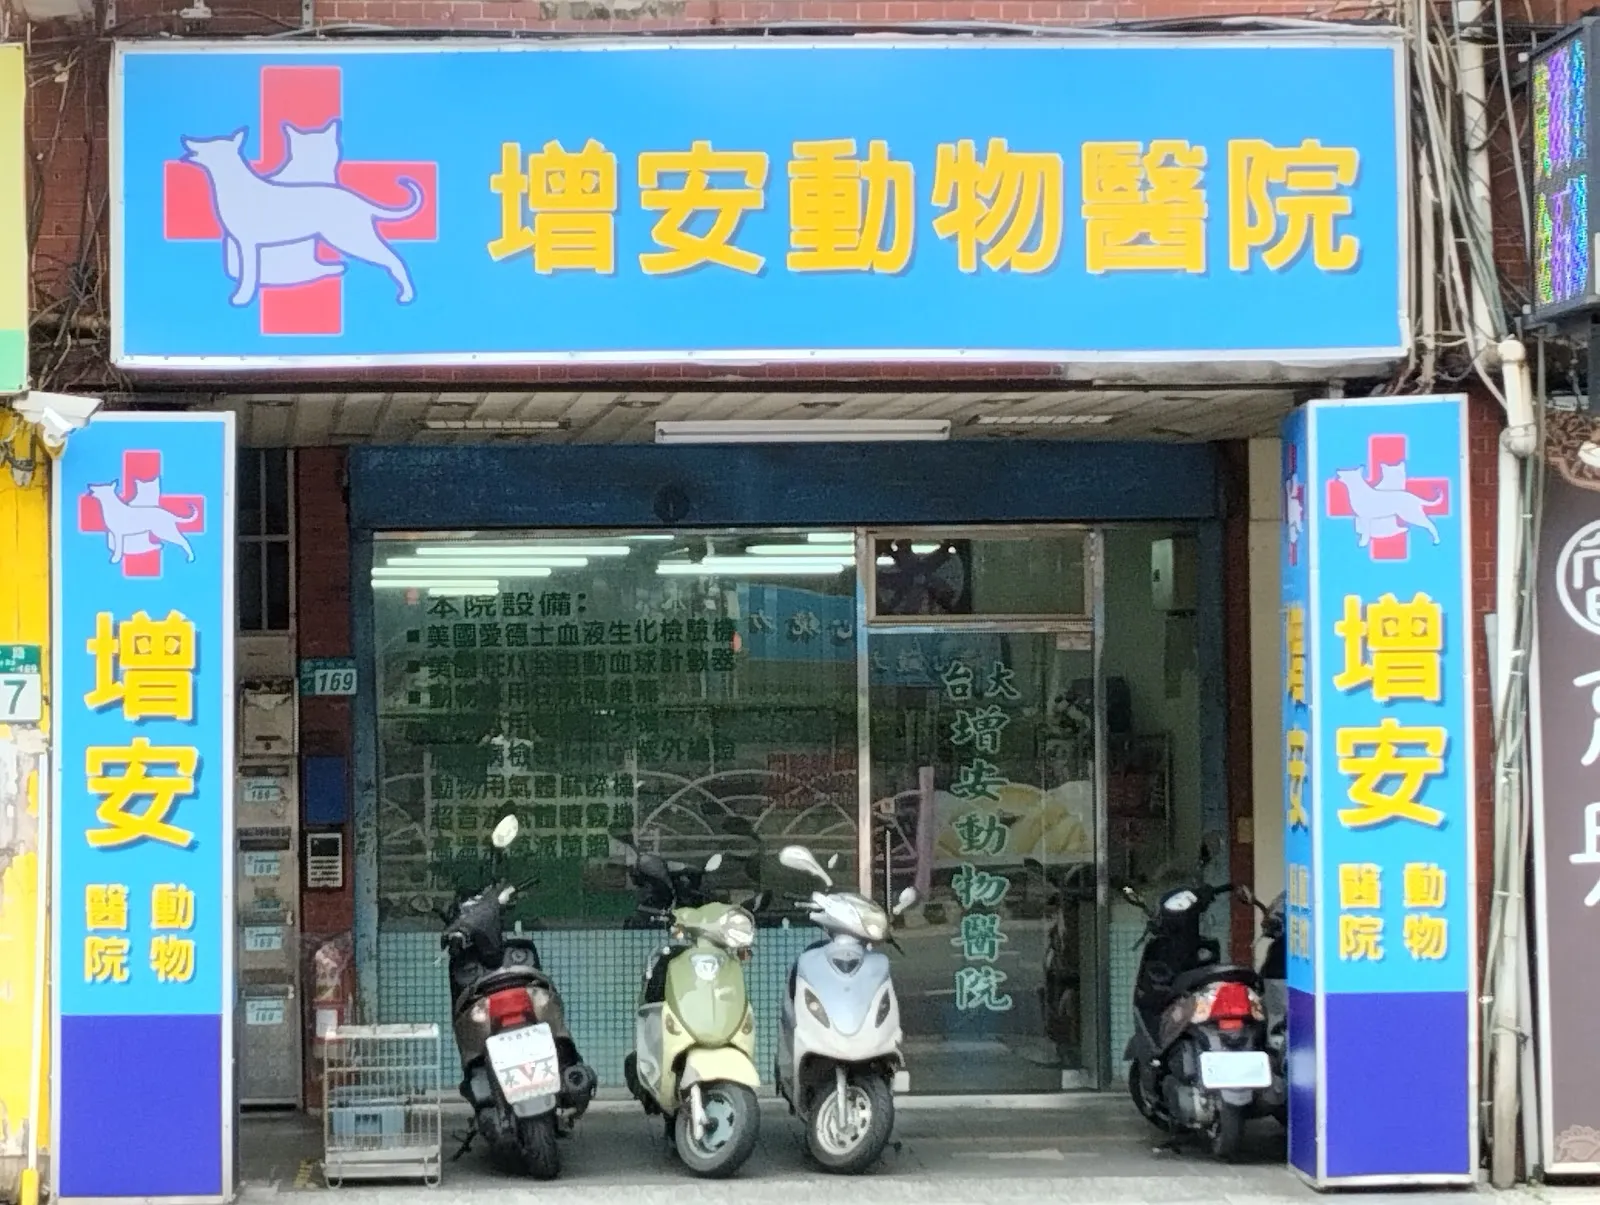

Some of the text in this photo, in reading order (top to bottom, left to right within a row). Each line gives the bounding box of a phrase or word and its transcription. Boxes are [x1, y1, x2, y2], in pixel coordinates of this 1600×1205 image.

[487, 138, 1360, 276] 增安動物醫院
[319, 672, 353, 691] 169
[426, 619, 738, 652] 美國愛德士血液生化檢驗機
[84, 609, 199, 848] 增安
[1333, 592, 1447, 828] 增安
[950, 704, 1013, 1012] 增安動物醫院
[84, 883, 130, 983] 醫院
[150, 883, 196, 983] 動物
[1337, 863, 1383, 961] 醫院
[1403, 862, 1448, 960] 動物
